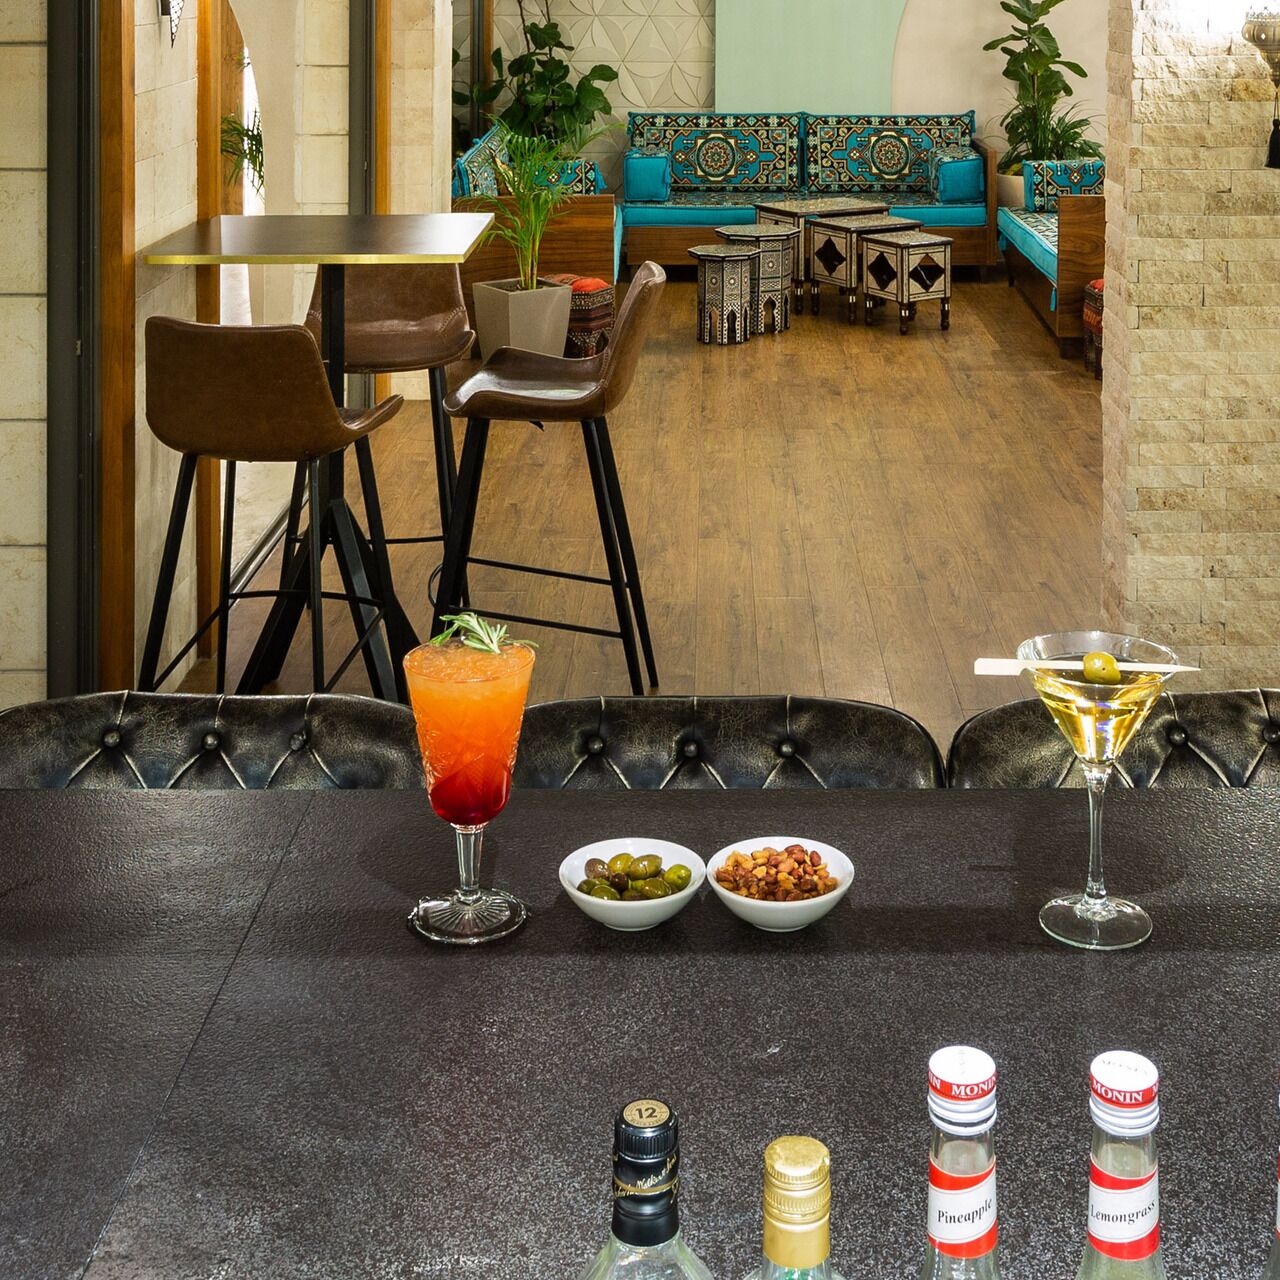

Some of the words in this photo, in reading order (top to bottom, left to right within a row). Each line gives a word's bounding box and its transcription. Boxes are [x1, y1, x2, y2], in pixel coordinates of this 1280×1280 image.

[1092, 1078, 1143, 1104] MONIN
[634, 1106, 658, 1119] 12
[937, 1197, 993, 1225] Pineapple
[1090, 1200, 1156, 1224] Lemongrass
